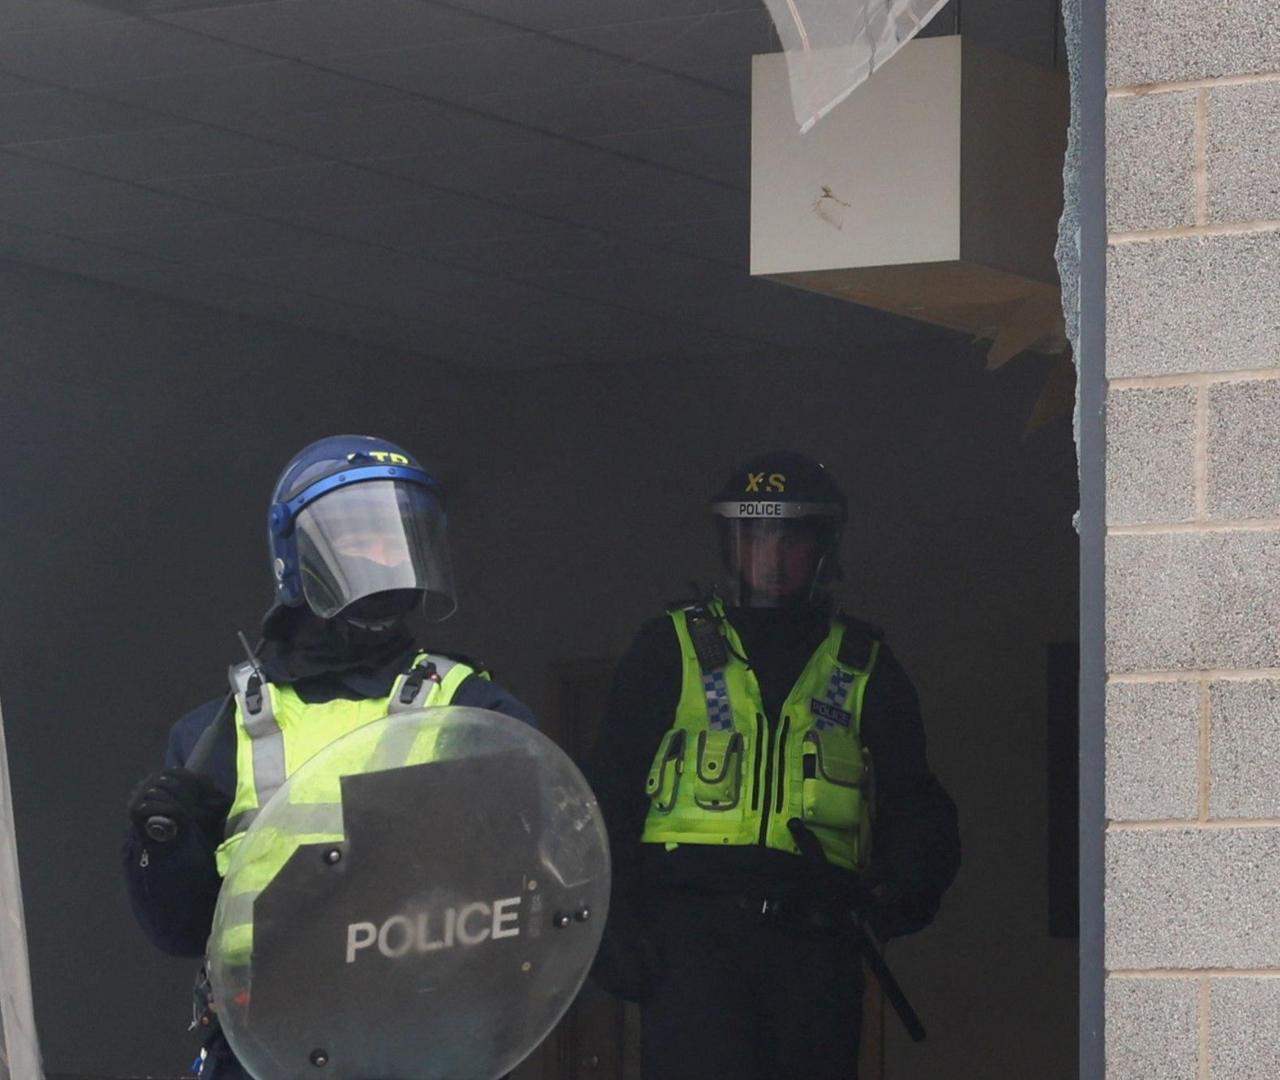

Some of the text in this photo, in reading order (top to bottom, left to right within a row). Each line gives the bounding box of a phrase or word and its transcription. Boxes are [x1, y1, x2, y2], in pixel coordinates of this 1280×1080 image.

[739, 503, 782, 516] POLICE
[813, 701, 849, 725] POLICE
[345, 897, 522, 964] POLICE
